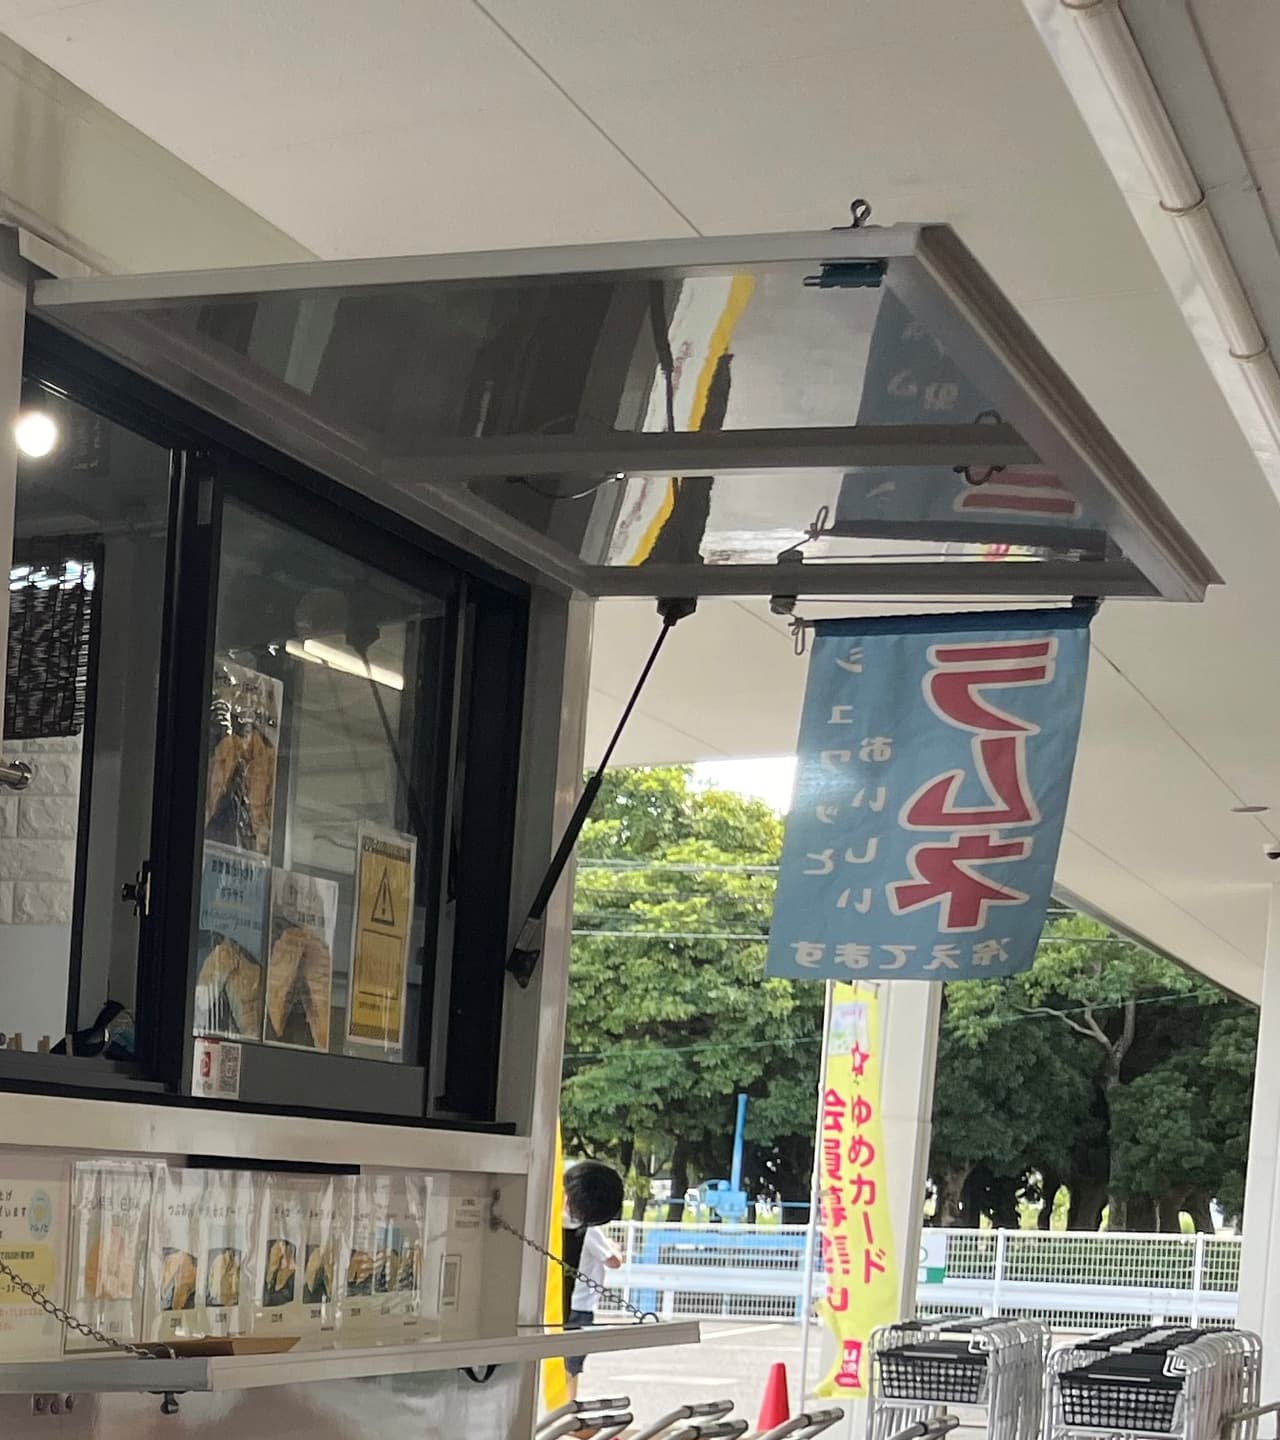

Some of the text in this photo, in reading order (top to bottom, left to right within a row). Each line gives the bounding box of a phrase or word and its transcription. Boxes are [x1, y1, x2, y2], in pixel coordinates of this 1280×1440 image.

[847, 1094, 886, 1284] ゆめカード
